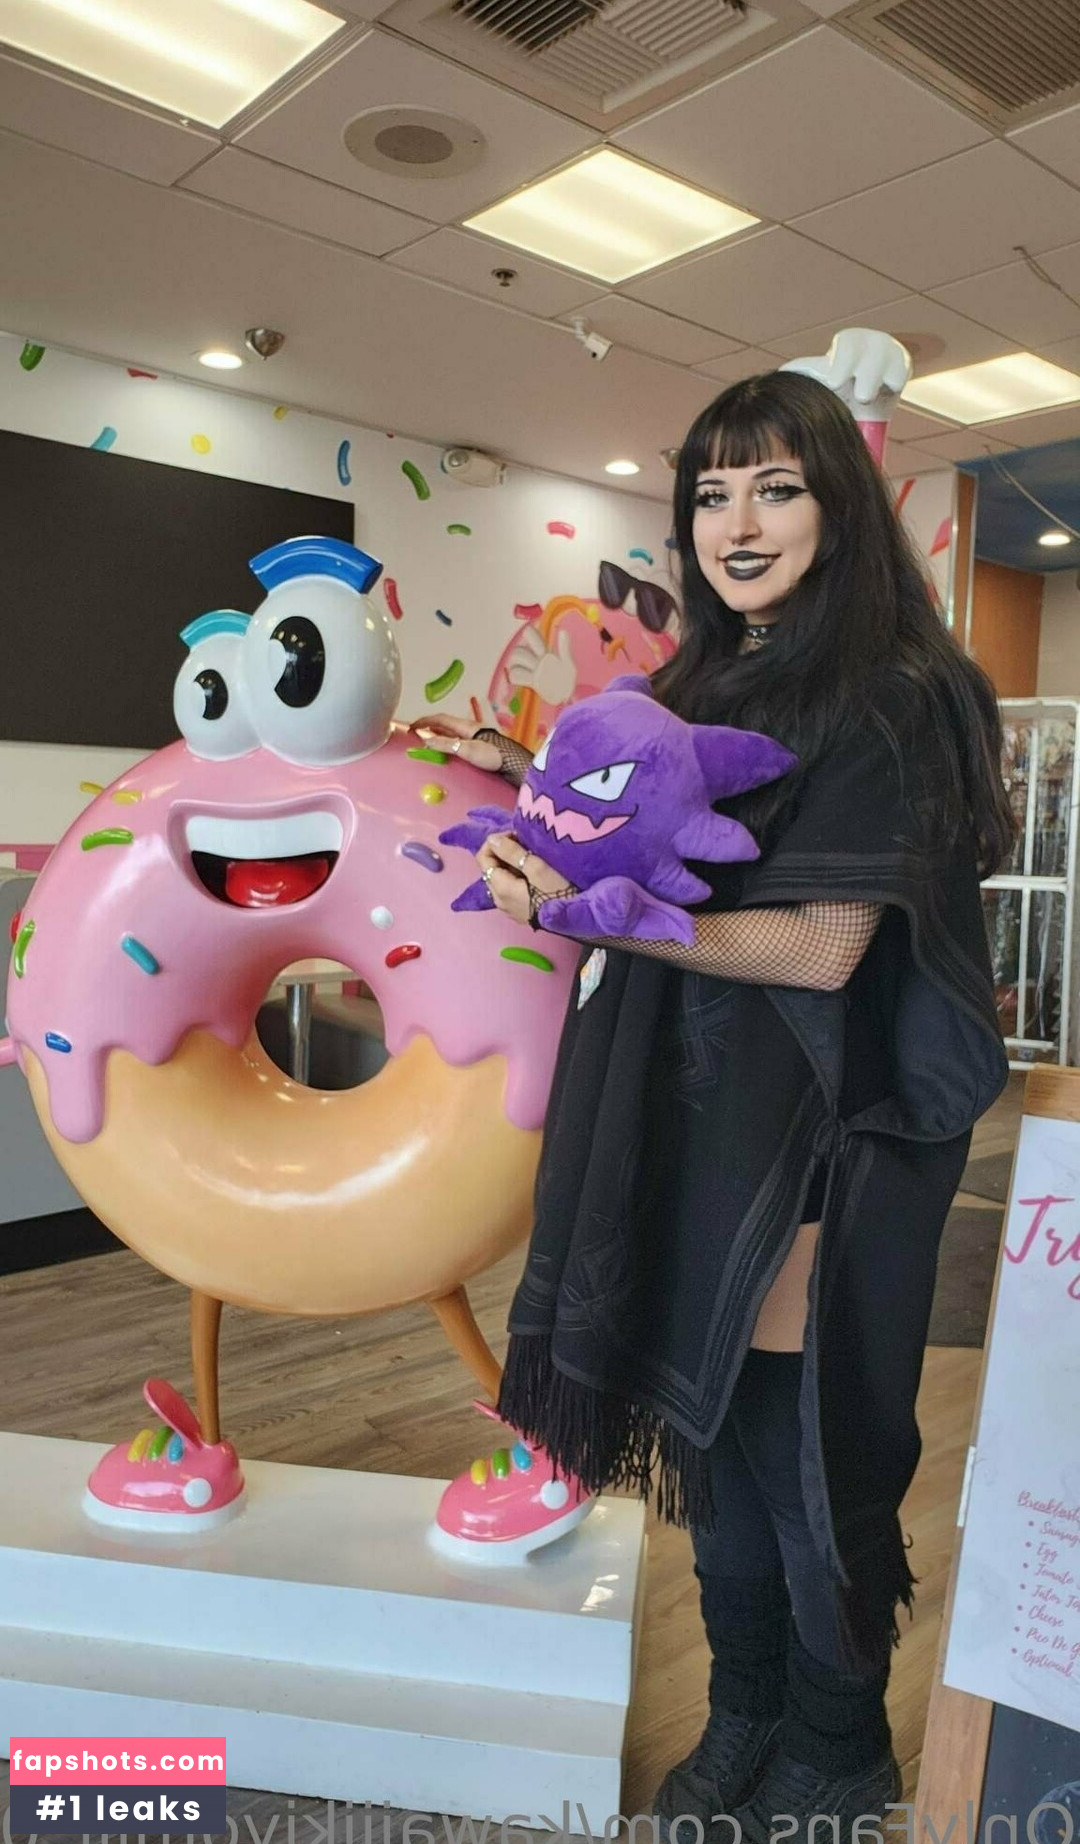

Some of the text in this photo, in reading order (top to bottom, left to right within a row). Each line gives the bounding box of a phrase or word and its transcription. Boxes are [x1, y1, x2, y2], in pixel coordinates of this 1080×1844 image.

[1036, 1541, 1058, 1564] Egg
[1034, 1562, 1074, 1585] Tomato
[1028, 1604, 1064, 1628] Cheese
[1026, 1627, 1049, 1643] Pico
